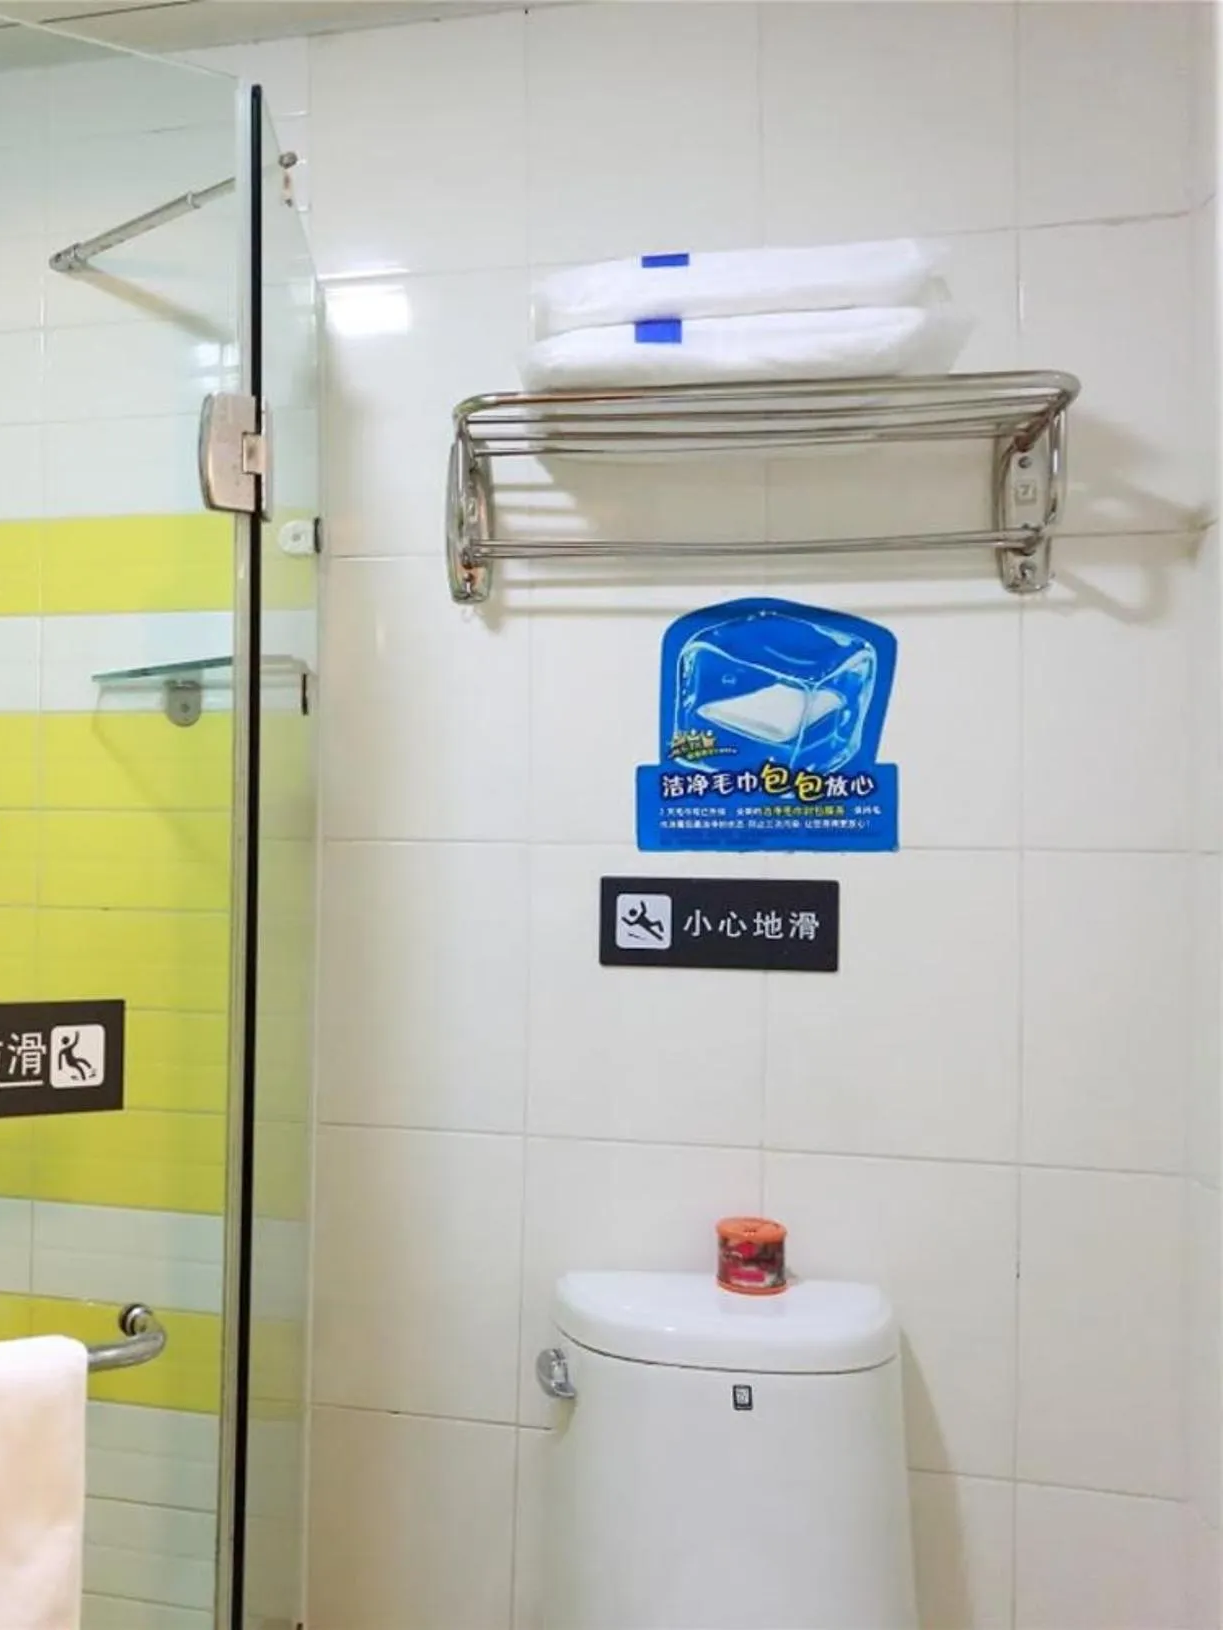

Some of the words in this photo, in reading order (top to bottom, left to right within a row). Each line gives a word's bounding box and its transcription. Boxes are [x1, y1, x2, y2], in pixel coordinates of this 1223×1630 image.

[662, 764, 874, 800] 洁净毛巾包包放心
[683, 909, 820, 940] 小心地滑
